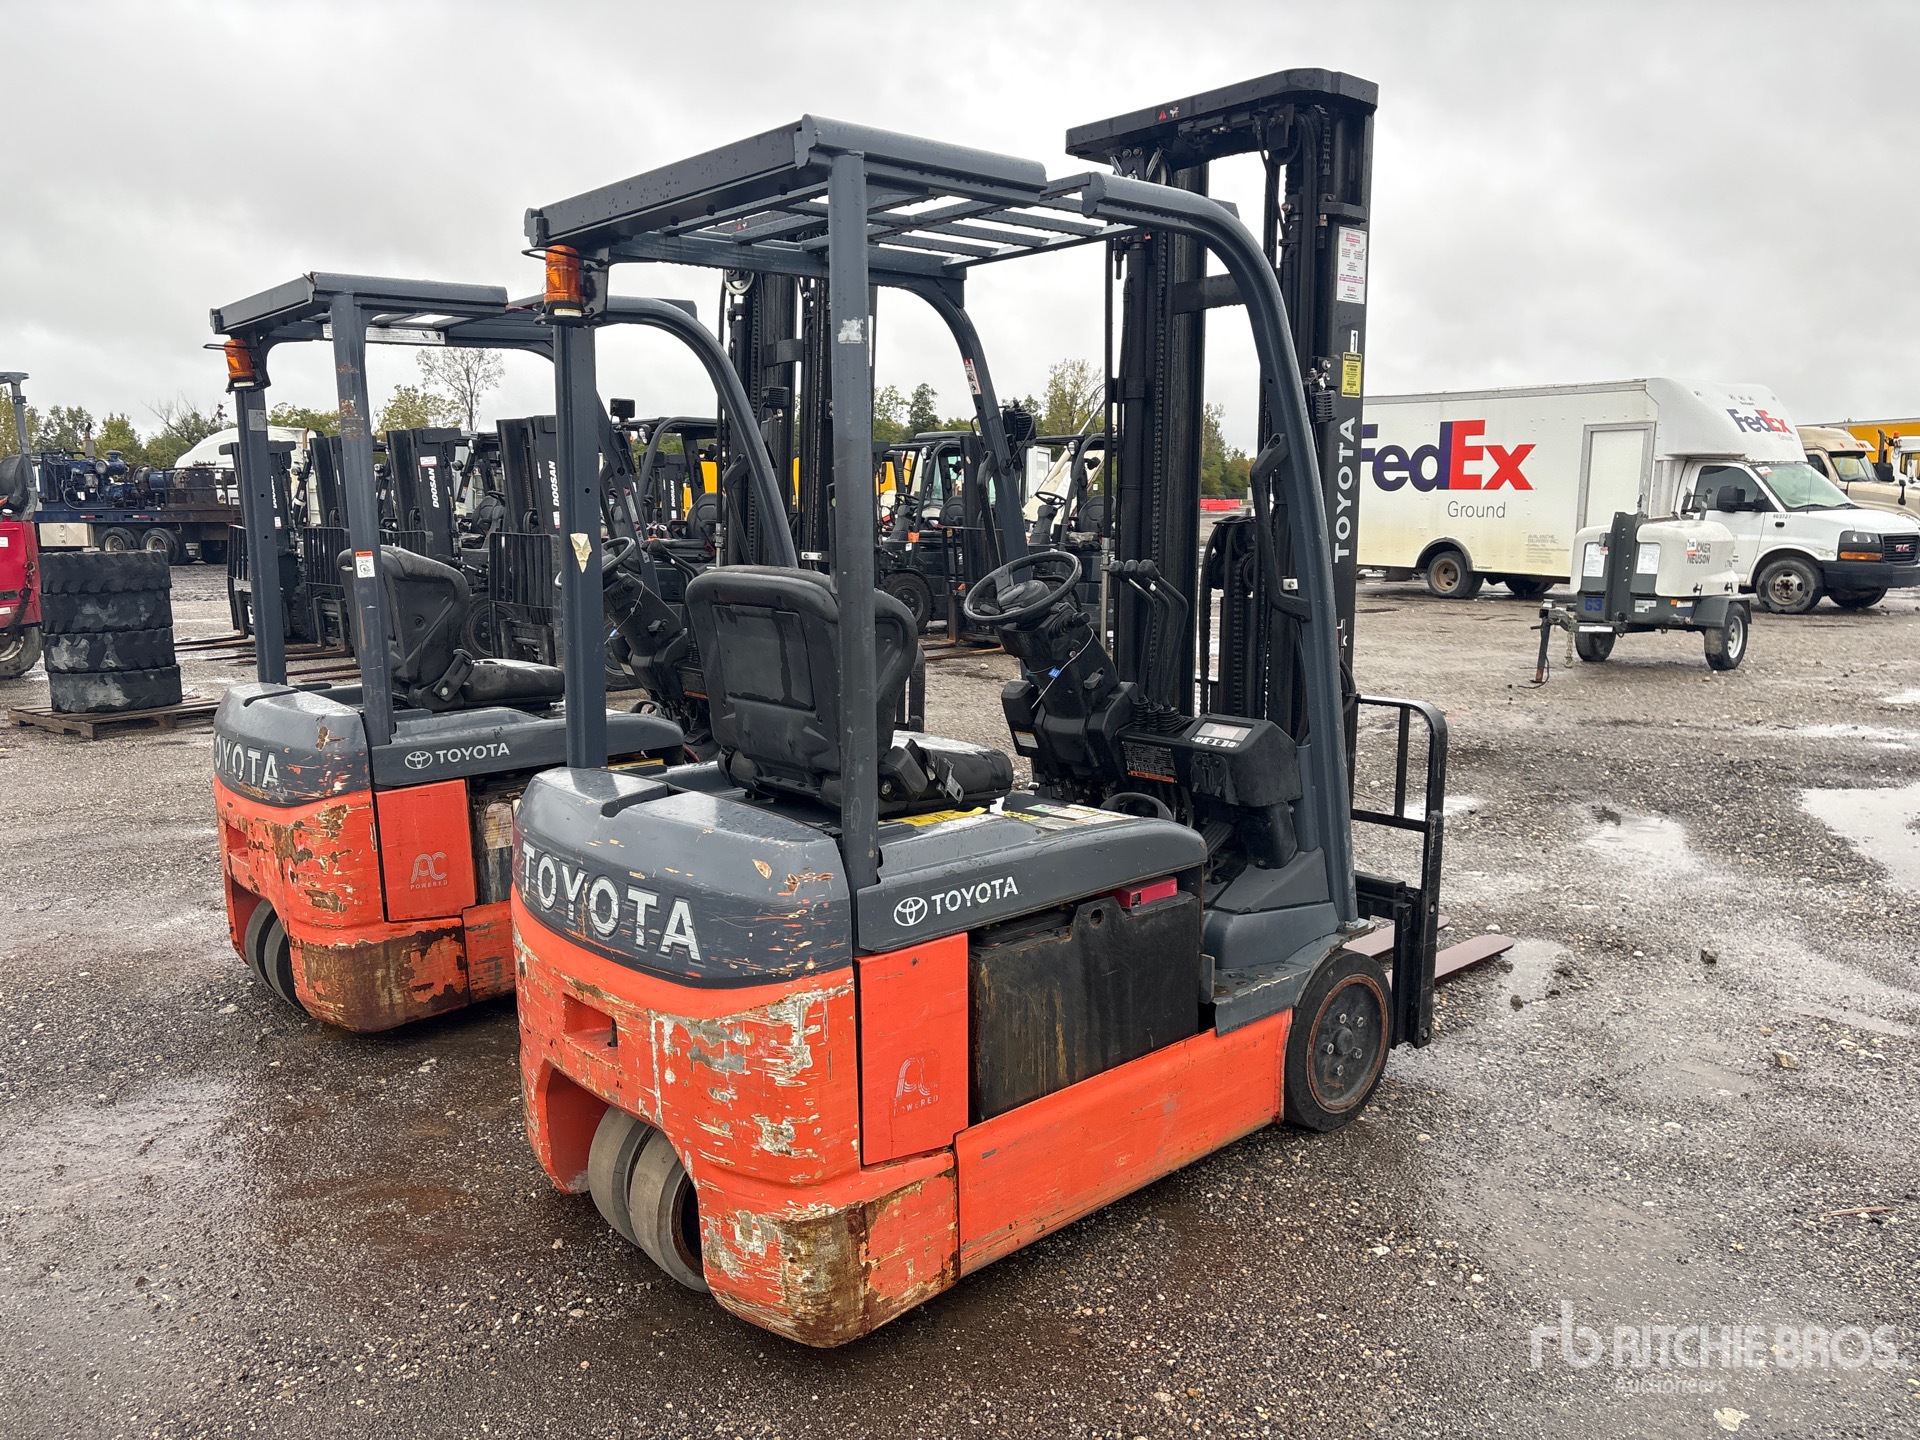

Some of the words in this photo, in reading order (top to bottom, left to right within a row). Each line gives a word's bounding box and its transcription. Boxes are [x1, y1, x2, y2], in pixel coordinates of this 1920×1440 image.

[1726, 409, 1793, 434] FedEx
[428, 467, 439, 508] DOOSAN
[548, 461, 560, 507] DOOSAN
[1334, 417, 1356, 564] TOYOTA
[1447, 501, 1506, 518] Ground
[436, 742, 511, 765] TOYOTA
[522, 841, 702, 961] TOYOTA
[931, 876, 1019, 914] TOYOTA
